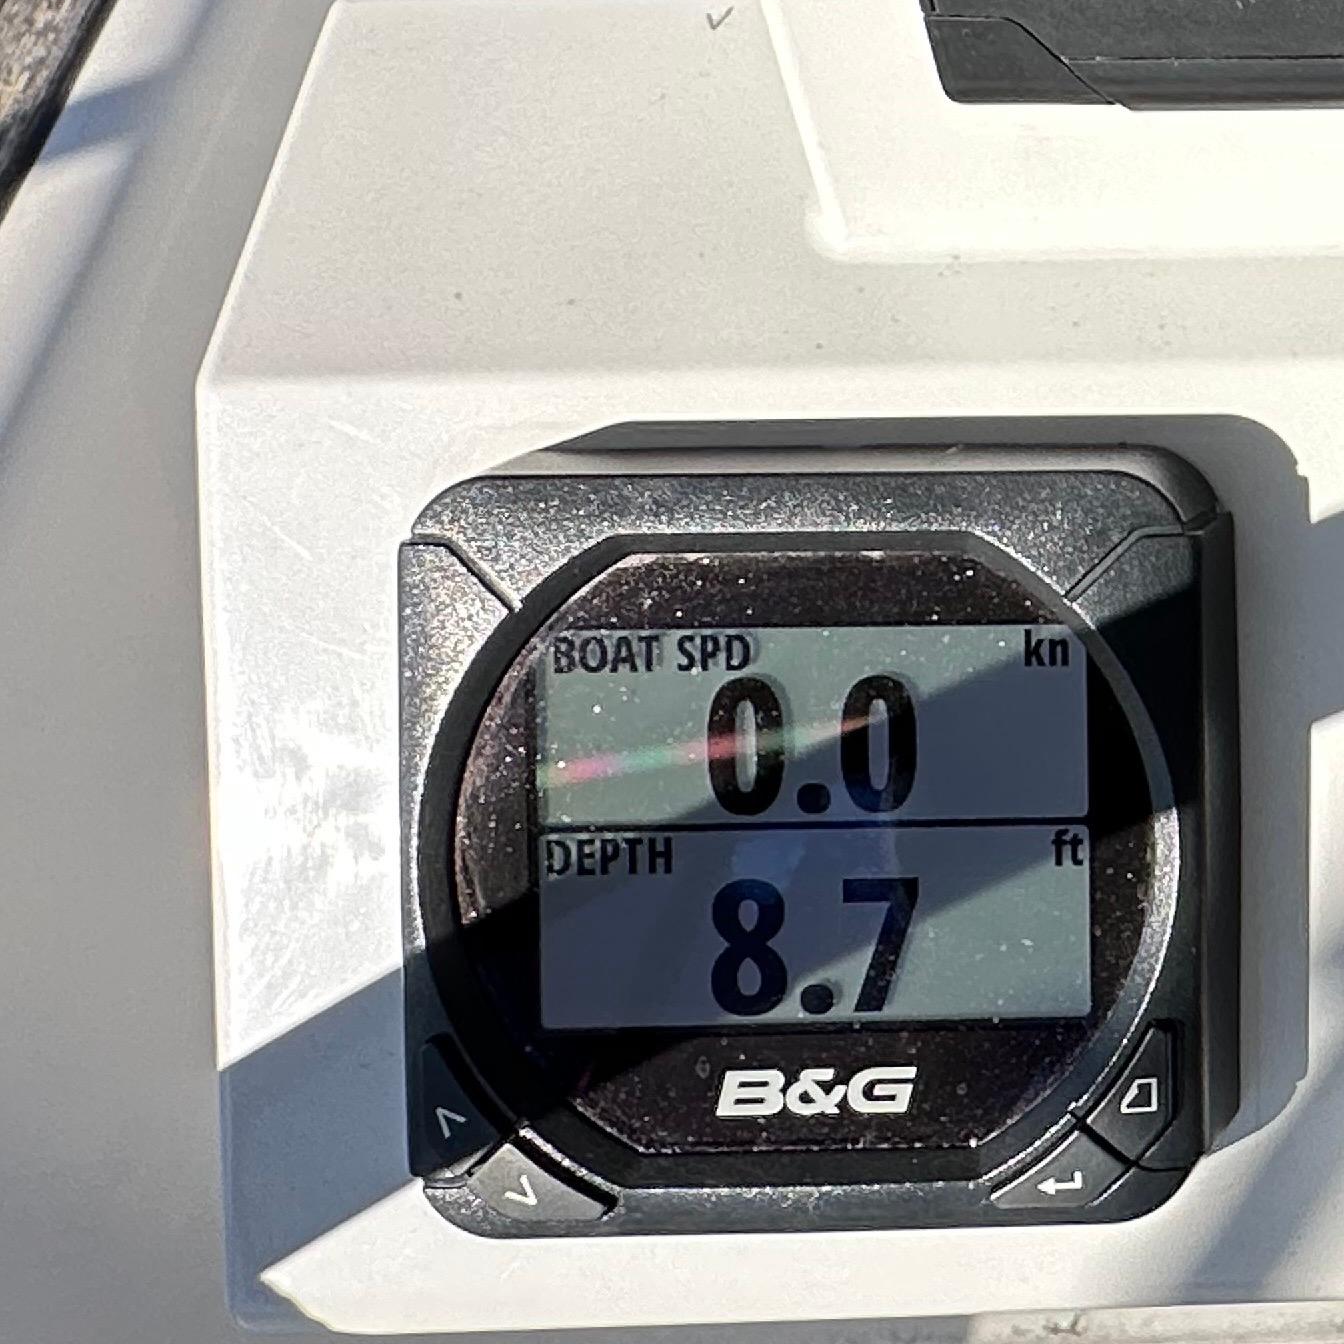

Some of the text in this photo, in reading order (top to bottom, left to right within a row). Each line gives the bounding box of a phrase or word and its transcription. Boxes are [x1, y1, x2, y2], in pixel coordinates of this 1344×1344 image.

[552, 632, 756, 675] BOAT SPD
[1022, 629, 1071, 668] kn
[706, 673, 918, 816] 0.0
[544, 836, 674, 876] DEPTH
[1050, 828, 1085, 867] ft
[710, 876, 920, 1017] 8.7
[715, 1066, 918, 1119] B&G
